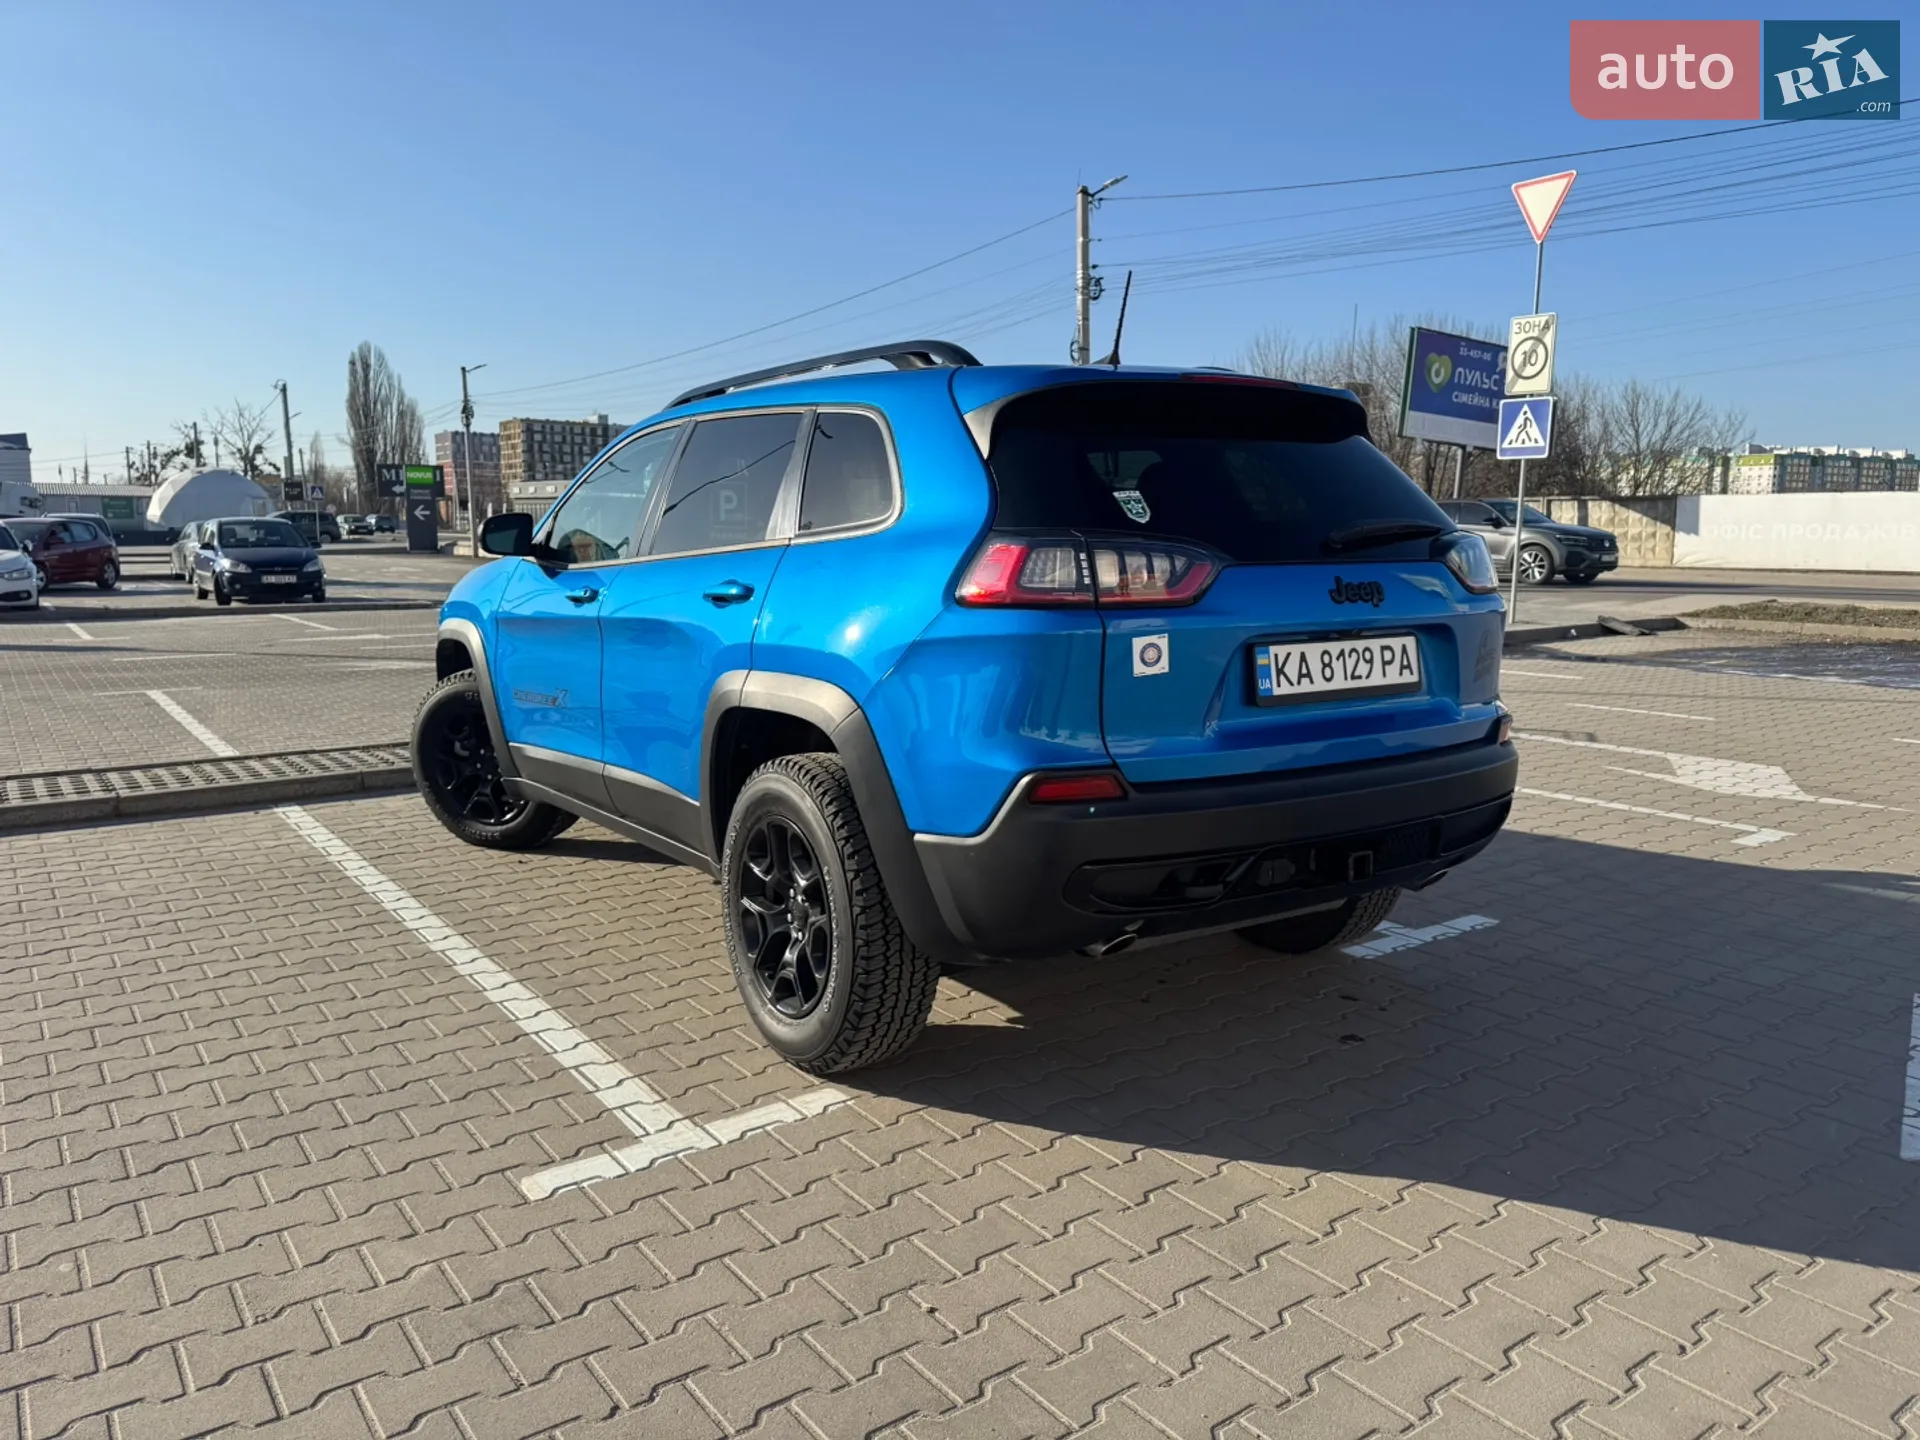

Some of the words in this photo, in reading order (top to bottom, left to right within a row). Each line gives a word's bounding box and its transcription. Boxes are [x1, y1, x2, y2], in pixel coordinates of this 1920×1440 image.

[1514, 320, 1550, 335] ЗОНА
[1521, 349, 1539, 368] 10
[1454, 367, 1499, 391] ПУЛЬС
[1451, 390, 1490, 408] СІМЕЙНА
[406, 471, 433, 479] NOVUS
[1703, 522, 1764, 540] ОФІС
[1771, 522, 1918, 543] ПРОДАЖІВ
[1328, 575, 1386, 608] Jeep
[1273, 650, 1315, 688] KA
[1320, 646, 1375, 683] 8129
[1379, 643, 1415, 679] PA
[1258, 677, 1272, 690] UA
